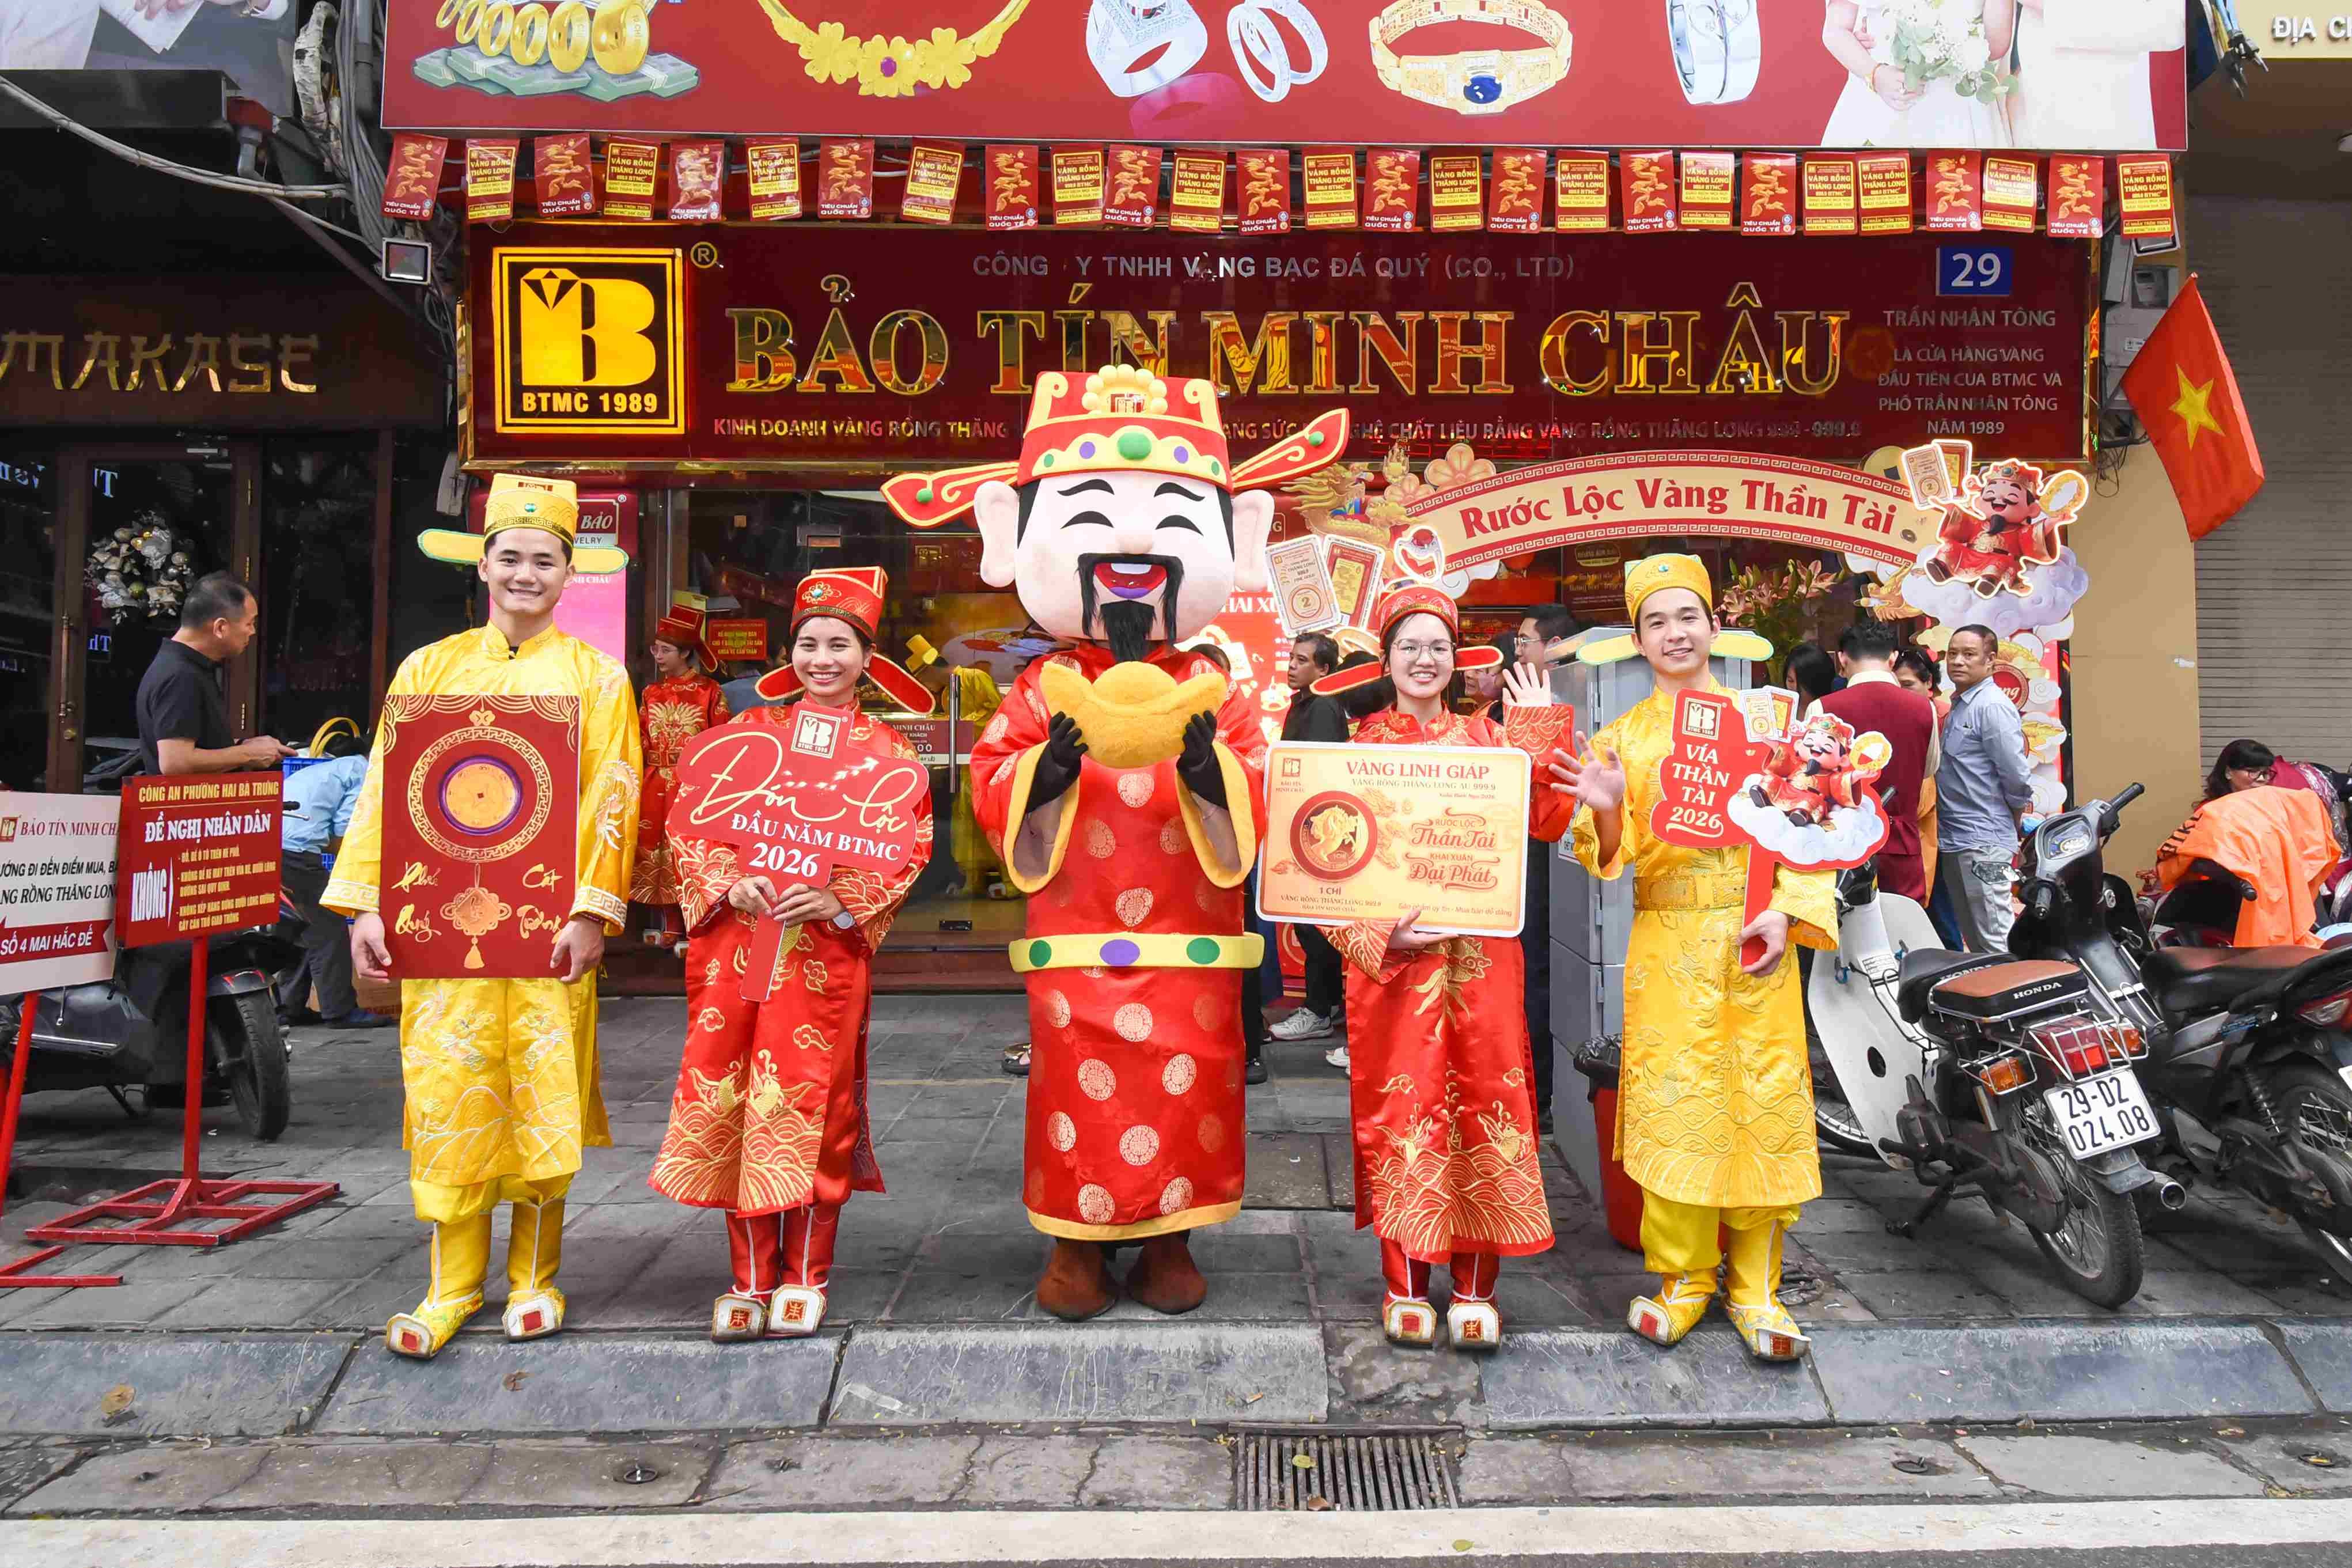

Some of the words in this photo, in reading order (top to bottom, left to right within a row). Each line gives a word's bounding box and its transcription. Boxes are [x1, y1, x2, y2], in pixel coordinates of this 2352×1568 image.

[2271, 16, 2317, 44] ĐỊA
[973, 251, 1048, 276] CÔNG
[1102, 257, 1172, 277] TNHH
[1266, 257, 1320, 282] BẠC
[1329, 252, 1365, 277] ĐÁ
[1375, 252, 1430, 279] QUÝ
[1516, 254, 1574, 279] LTD)
[1951, 252, 2001, 287] 29
[1941, 307, 1995, 327] NHÂN
[2001, 305, 2056, 327] TÔNG
[725, 274, 949, 395] BẢO
[978, 283, 1176, 394] TÍN
[1201, 311, 1514, 395] MINH
[1540, 282, 1850, 396] CHÂU
[1952, 347, 1997, 362] HÀNG
[1992, 373, 2037, 387] BTMC
[522, 392, 589, 412] BTMC
[599, 392, 657, 412] 1989
[2012, 394, 2058, 411] TÔNG
[714, 419, 756, 435] KINH
[760, 419, 826, 437] DOANH
[832, 416, 883, 437] VÀNG
[1927, 419, 1965, 434] NĂM
[1970, 421, 2005, 434] 1989
[1459, 497, 1552, 539] Rước
[1562, 484, 1626, 520] Lộc
[1635, 478, 1730, 514] Vàng
[1740, 479, 1829, 520] Thần
[1843, 494, 1897, 535] Tài
[581, 512, 613, 530] BẢO
[1686, 744, 1719, 765] VÍA
[1346, 759, 1395, 775] VÀNG
[1400, 763, 1441, 778] LINH
[1446, 763, 1490, 779] GIÁP
[1672, 761, 1730, 787] THẦN
[139, 785, 166, 802] CÔNG
[167, 786, 181, 801] AN
[183, 782, 220, 800] PHƯỜNG
[222, 783, 237, 798] HAI
[252, 781, 279, 796] TRƯNG
[1682, 786, 1715, 806] TÀI
[20, 817, 46, 836] BẢO
[48, 819, 69, 836] TÍN
[69, 822, 99, 835] MINH
[101, 822, 117, 835] CH
[167, 818, 202, 844] NGHỊ
[204, 810, 242, 837] NHÂN
[244, 808, 271, 834] DÂN
[1670, 806, 1722, 829] 2026
[732, 810, 778, 836] ĐẦU
[782, 823, 834, 848] NĂM
[835, 835, 902, 861] BTMC
[1411, 828, 1462, 847] Thần
[1463, 830, 1497, 848] Tài
[0, 859, 25, 877] ƯỚNG
[28, 863, 37, 876] ĐI
[40, 856, 59, 876] ĐẾN
[62, 856, 84, 875] ĐIỂM
[86, 861, 106, 876] MUA,
[749, 843, 820, 877] 2026
[1410, 862, 1446, 884] Đại
[1449, 864, 1492, 883] Phát
[20, 883, 53, 904] RỒNG
[56, 884, 92, 901] THĂNG
[94, 884, 116, 899] LON
[131, 862, 167, 922] KHÔNG
[1, 931, 18, 956] SỐ
[20, 938, 27, 953] 4
[29, 936, 51, 952] MAI
[52, 926, 76, 950] HẮC
[77, 923, 93, 946] ĐẾ
[2013, 982, 2062, 999] HONDA
[2061, 1077, 2129, 1119] 29-D2
[2069, 1105, 2150, 1151] 024.08
